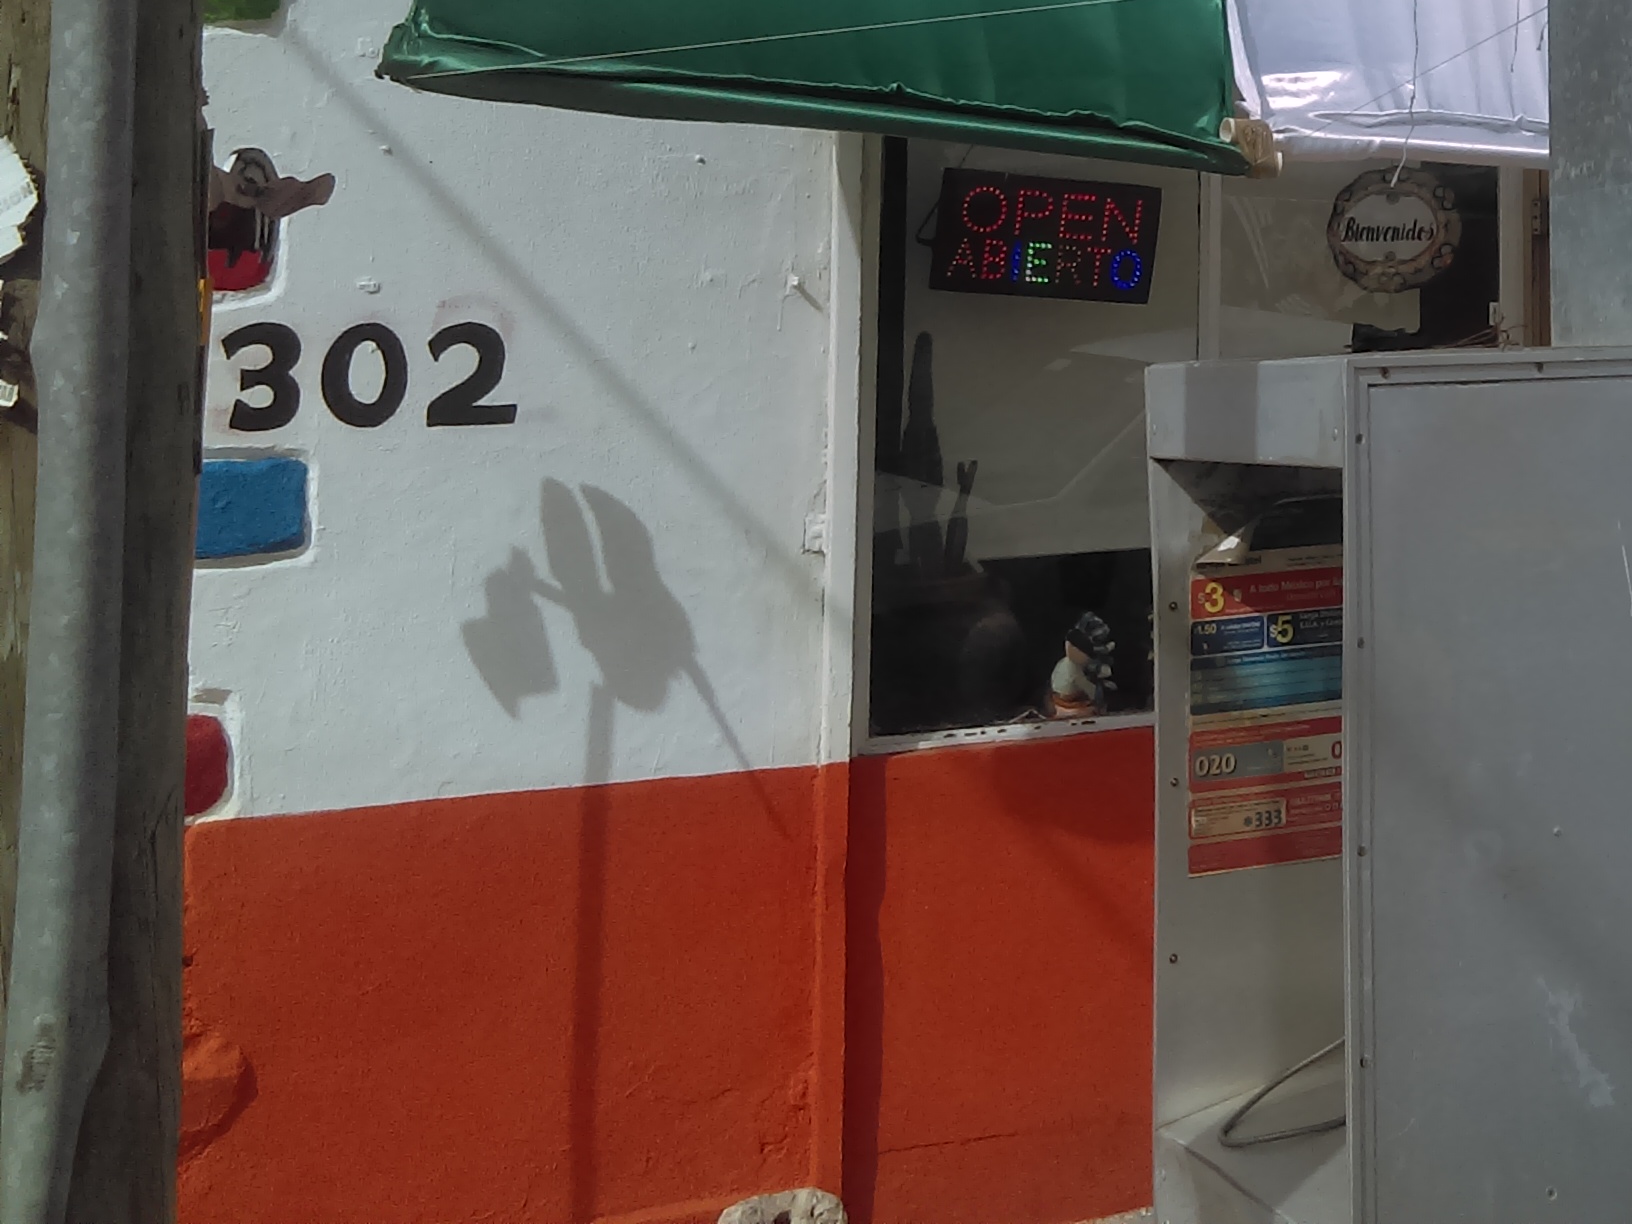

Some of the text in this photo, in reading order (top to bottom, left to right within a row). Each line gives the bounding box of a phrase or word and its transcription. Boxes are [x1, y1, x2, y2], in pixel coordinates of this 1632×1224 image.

[962, 186, 1142, 245] OPEN
[946, 237, 1142, 290] ABIERTO
[220, 321, 518, 432] 302
[1195, 753, 1237, 777] 020
